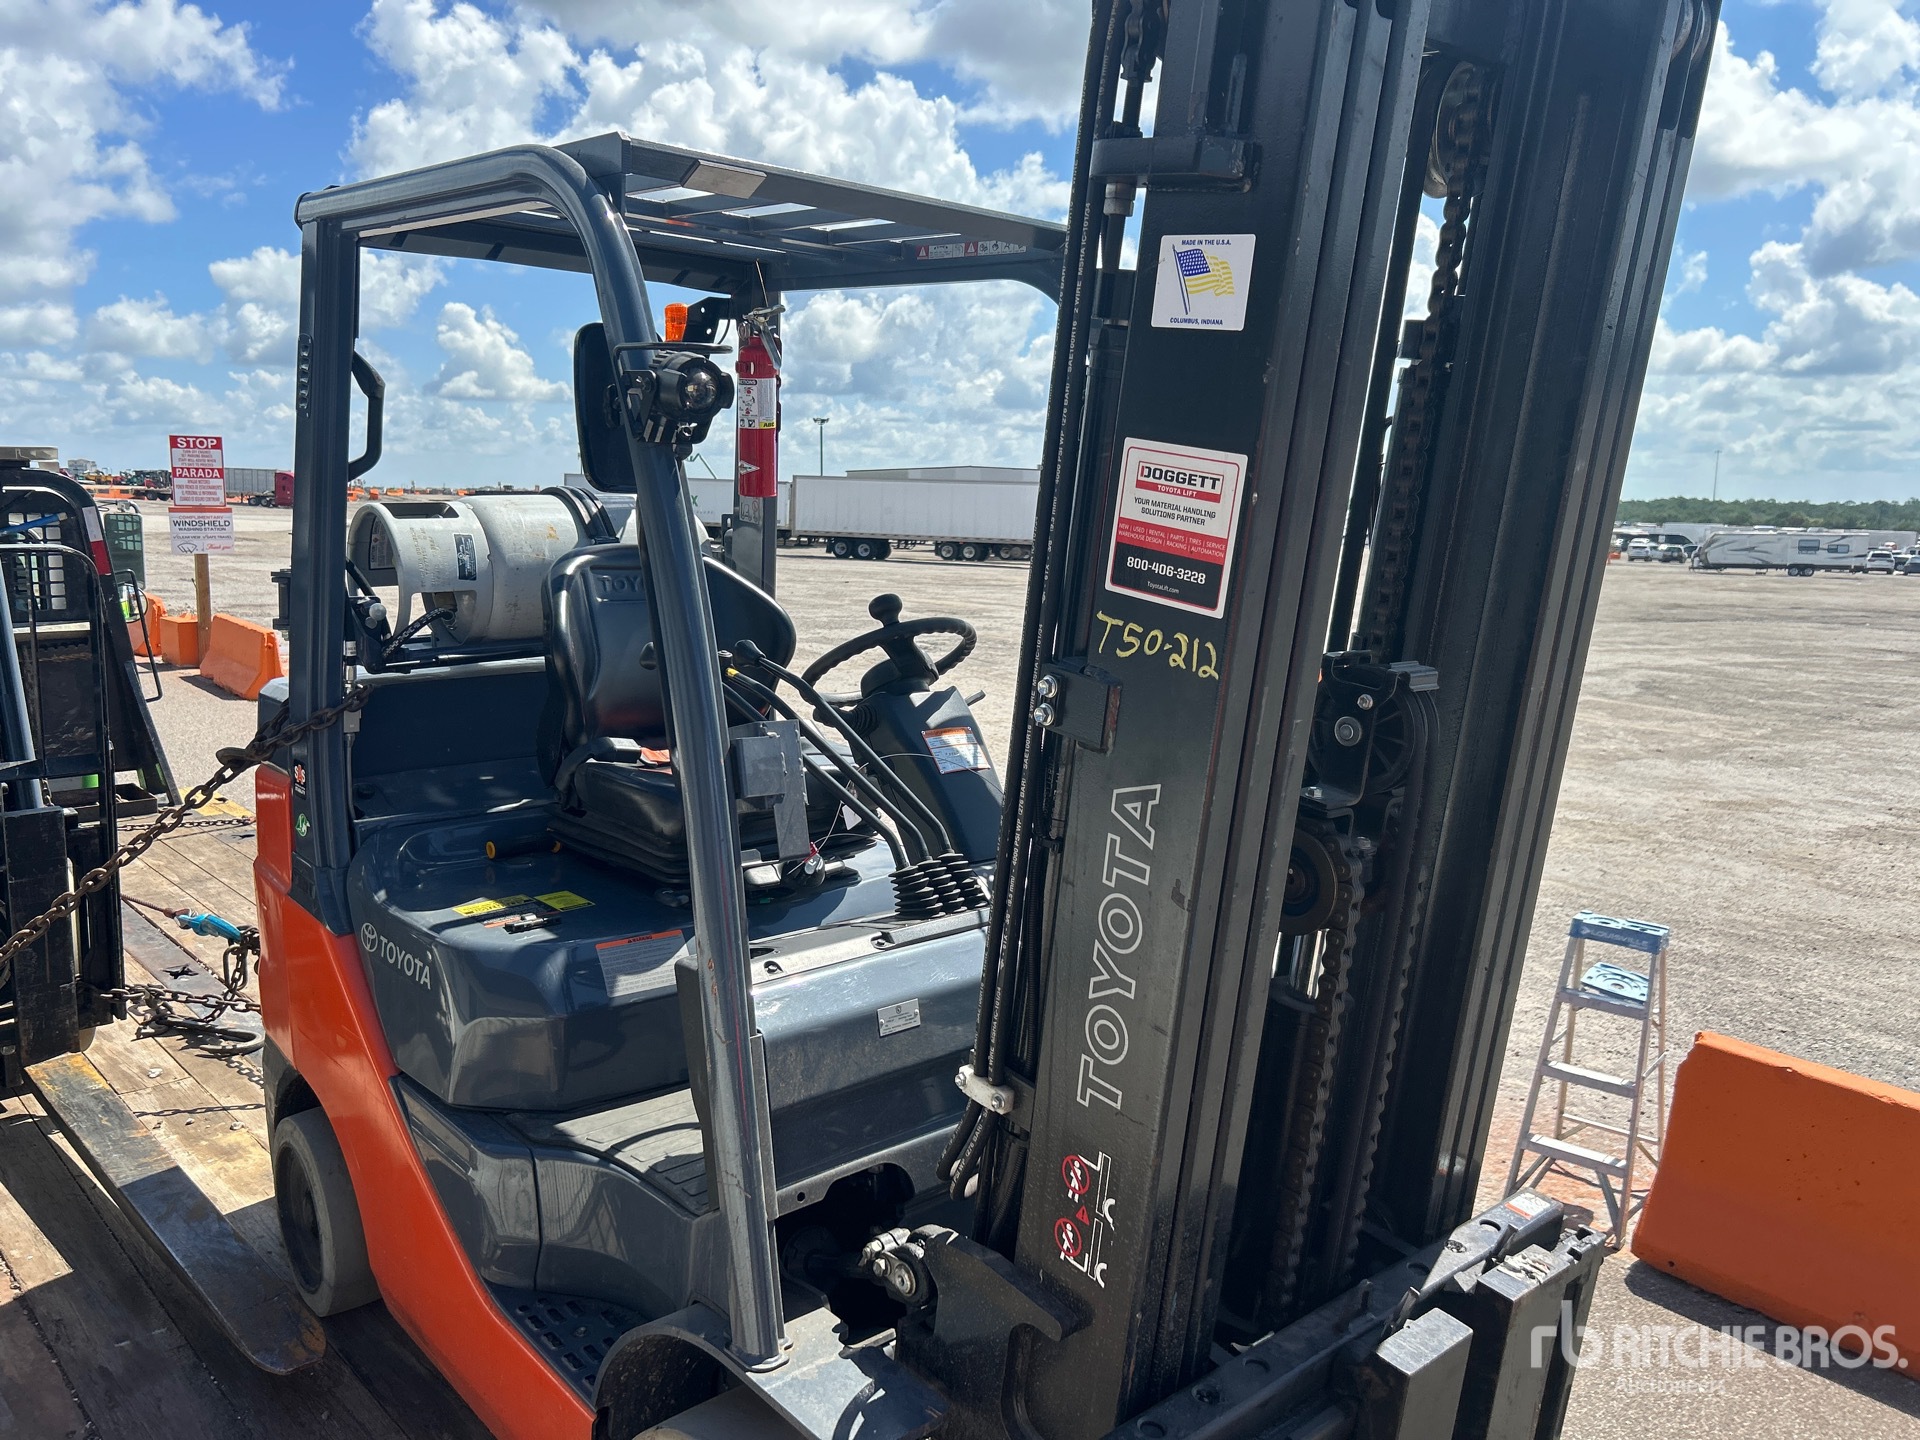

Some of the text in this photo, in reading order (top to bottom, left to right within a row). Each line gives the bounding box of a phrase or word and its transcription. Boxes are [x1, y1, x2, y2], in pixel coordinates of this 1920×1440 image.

[177, 437, 217, 449] STOP
[176, 468, 220, 478] PARADA
[1141, 466, 1221, 490] DOGGETT
[1157, 485, 1181, 495] TOYOTA
[1134, 496, 1216, 519] YOUR MATERIAL HANDLING
[1141, 507, 1206, 526] SOLUTIONS PARTNER
[1118, 530, 1145, 541] WAREHOUSE
[1146, 536, 1162, 545] DESIGN
[1166, 541, 1187, 551] RACKING
[1191, 546, 1224, 558] AUTOMATION
[1132, 526, 1145, 534] USED
[1149, 529, 1166, 538] RENTAL
[1170, 534, 1185, 542] PARTS
[1189, 538, 1202, 546] TIRES
[1206, 542, 1226, 550] SERVICE
[1126, 556, 1206, 585] 800-406-3228
[1147, 581, 1180, 594] ToyotaLift.com
[1076, 784, 1161, 1110] TOYOTA
[380, 935, 431, 990] TOYOTA
